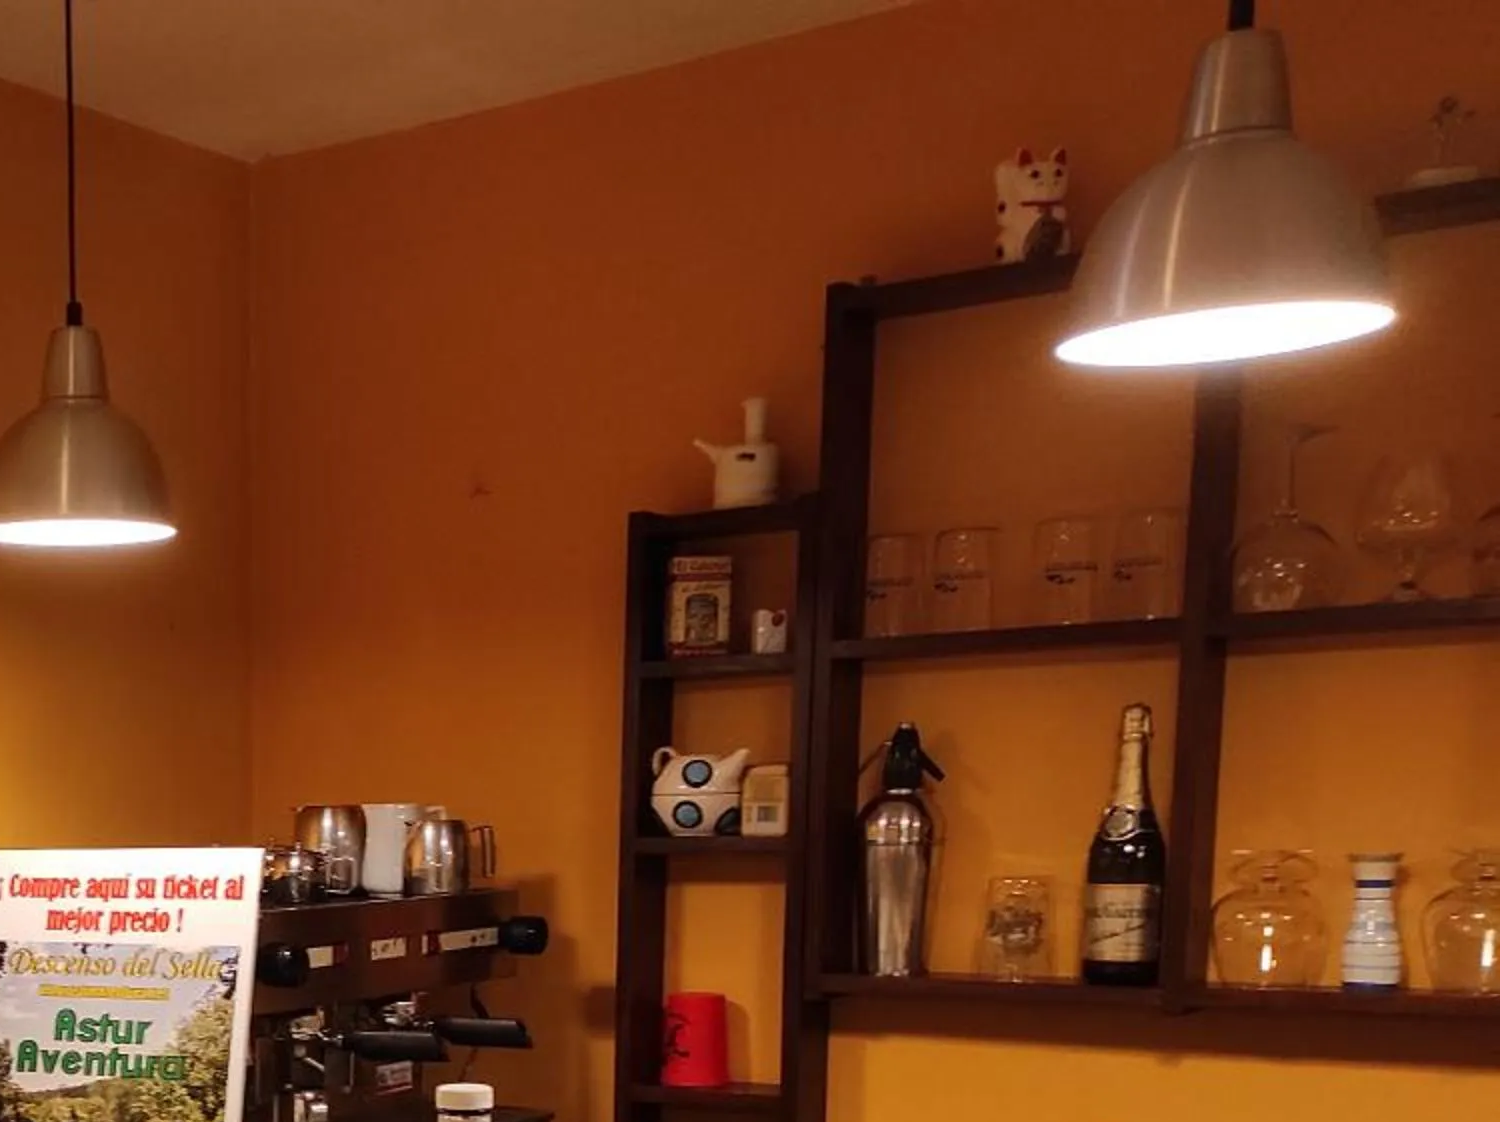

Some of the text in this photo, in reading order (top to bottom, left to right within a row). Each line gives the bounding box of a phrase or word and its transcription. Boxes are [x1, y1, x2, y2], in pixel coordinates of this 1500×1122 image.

[9, 873, 81, 900] Compre
[136, 877, 157, 899] su
[163, 874, 219, 901] ticket
[225, 874, 245, 901] al
[46, 907, 104, 934] mejor
[109, 907, 171, 935] precio
[7, 946, 224, 981] Descenso del Sella
[53, 1008, 155, 1045] Astur
[16, 1040, 190, 1081] Aventura
